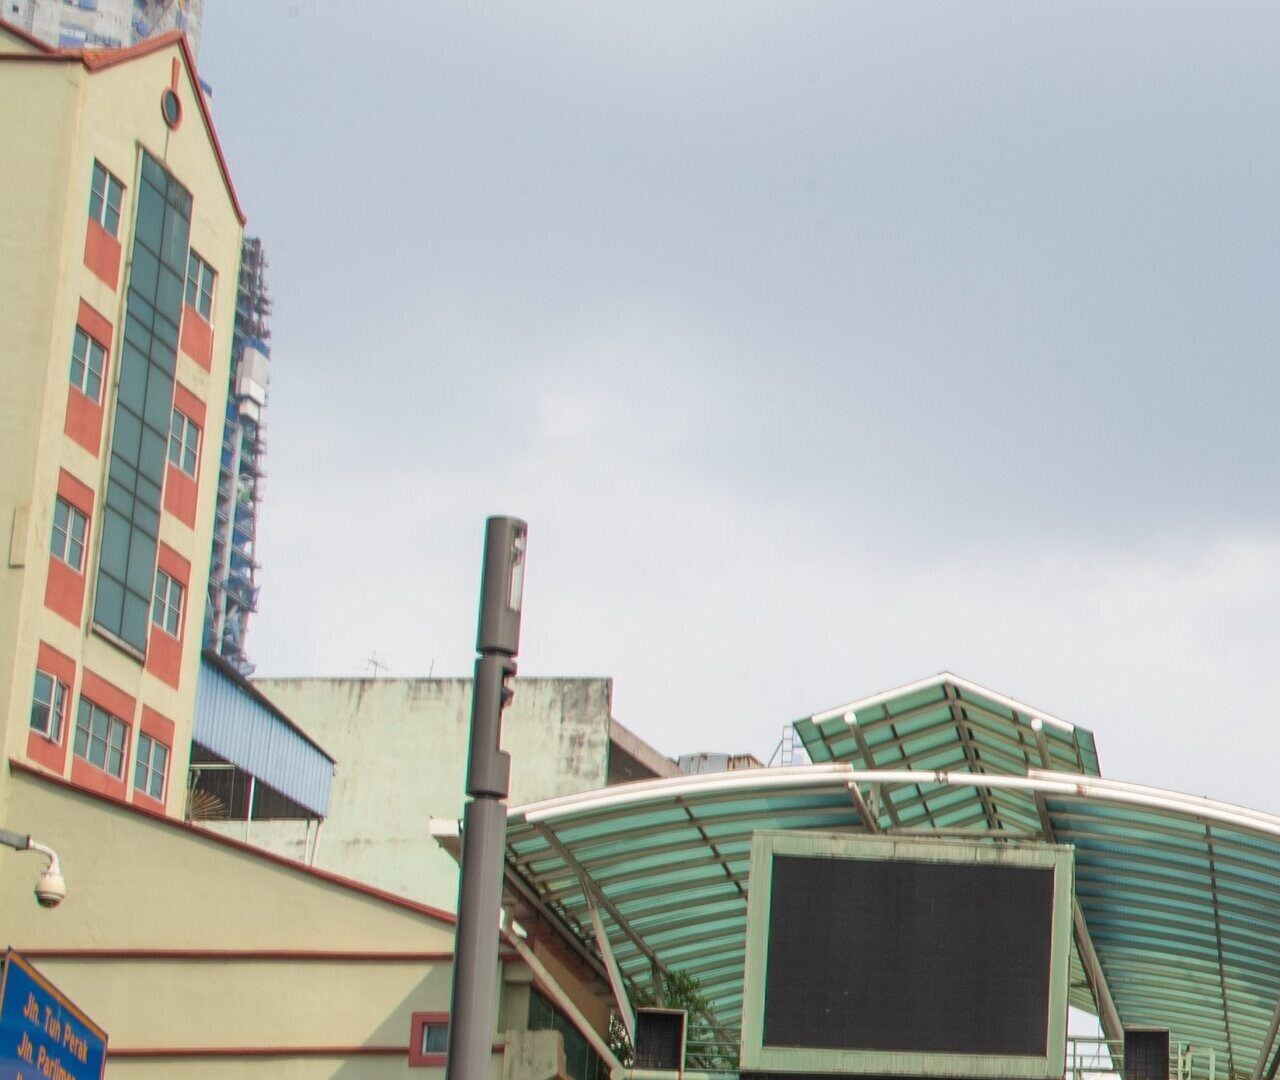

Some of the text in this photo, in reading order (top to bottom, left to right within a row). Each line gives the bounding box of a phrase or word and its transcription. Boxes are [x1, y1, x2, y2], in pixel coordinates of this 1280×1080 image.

[17, 1031, 34, 1066] Jln.
[22, 992, 88, 1065] Jln. Tun Perak
